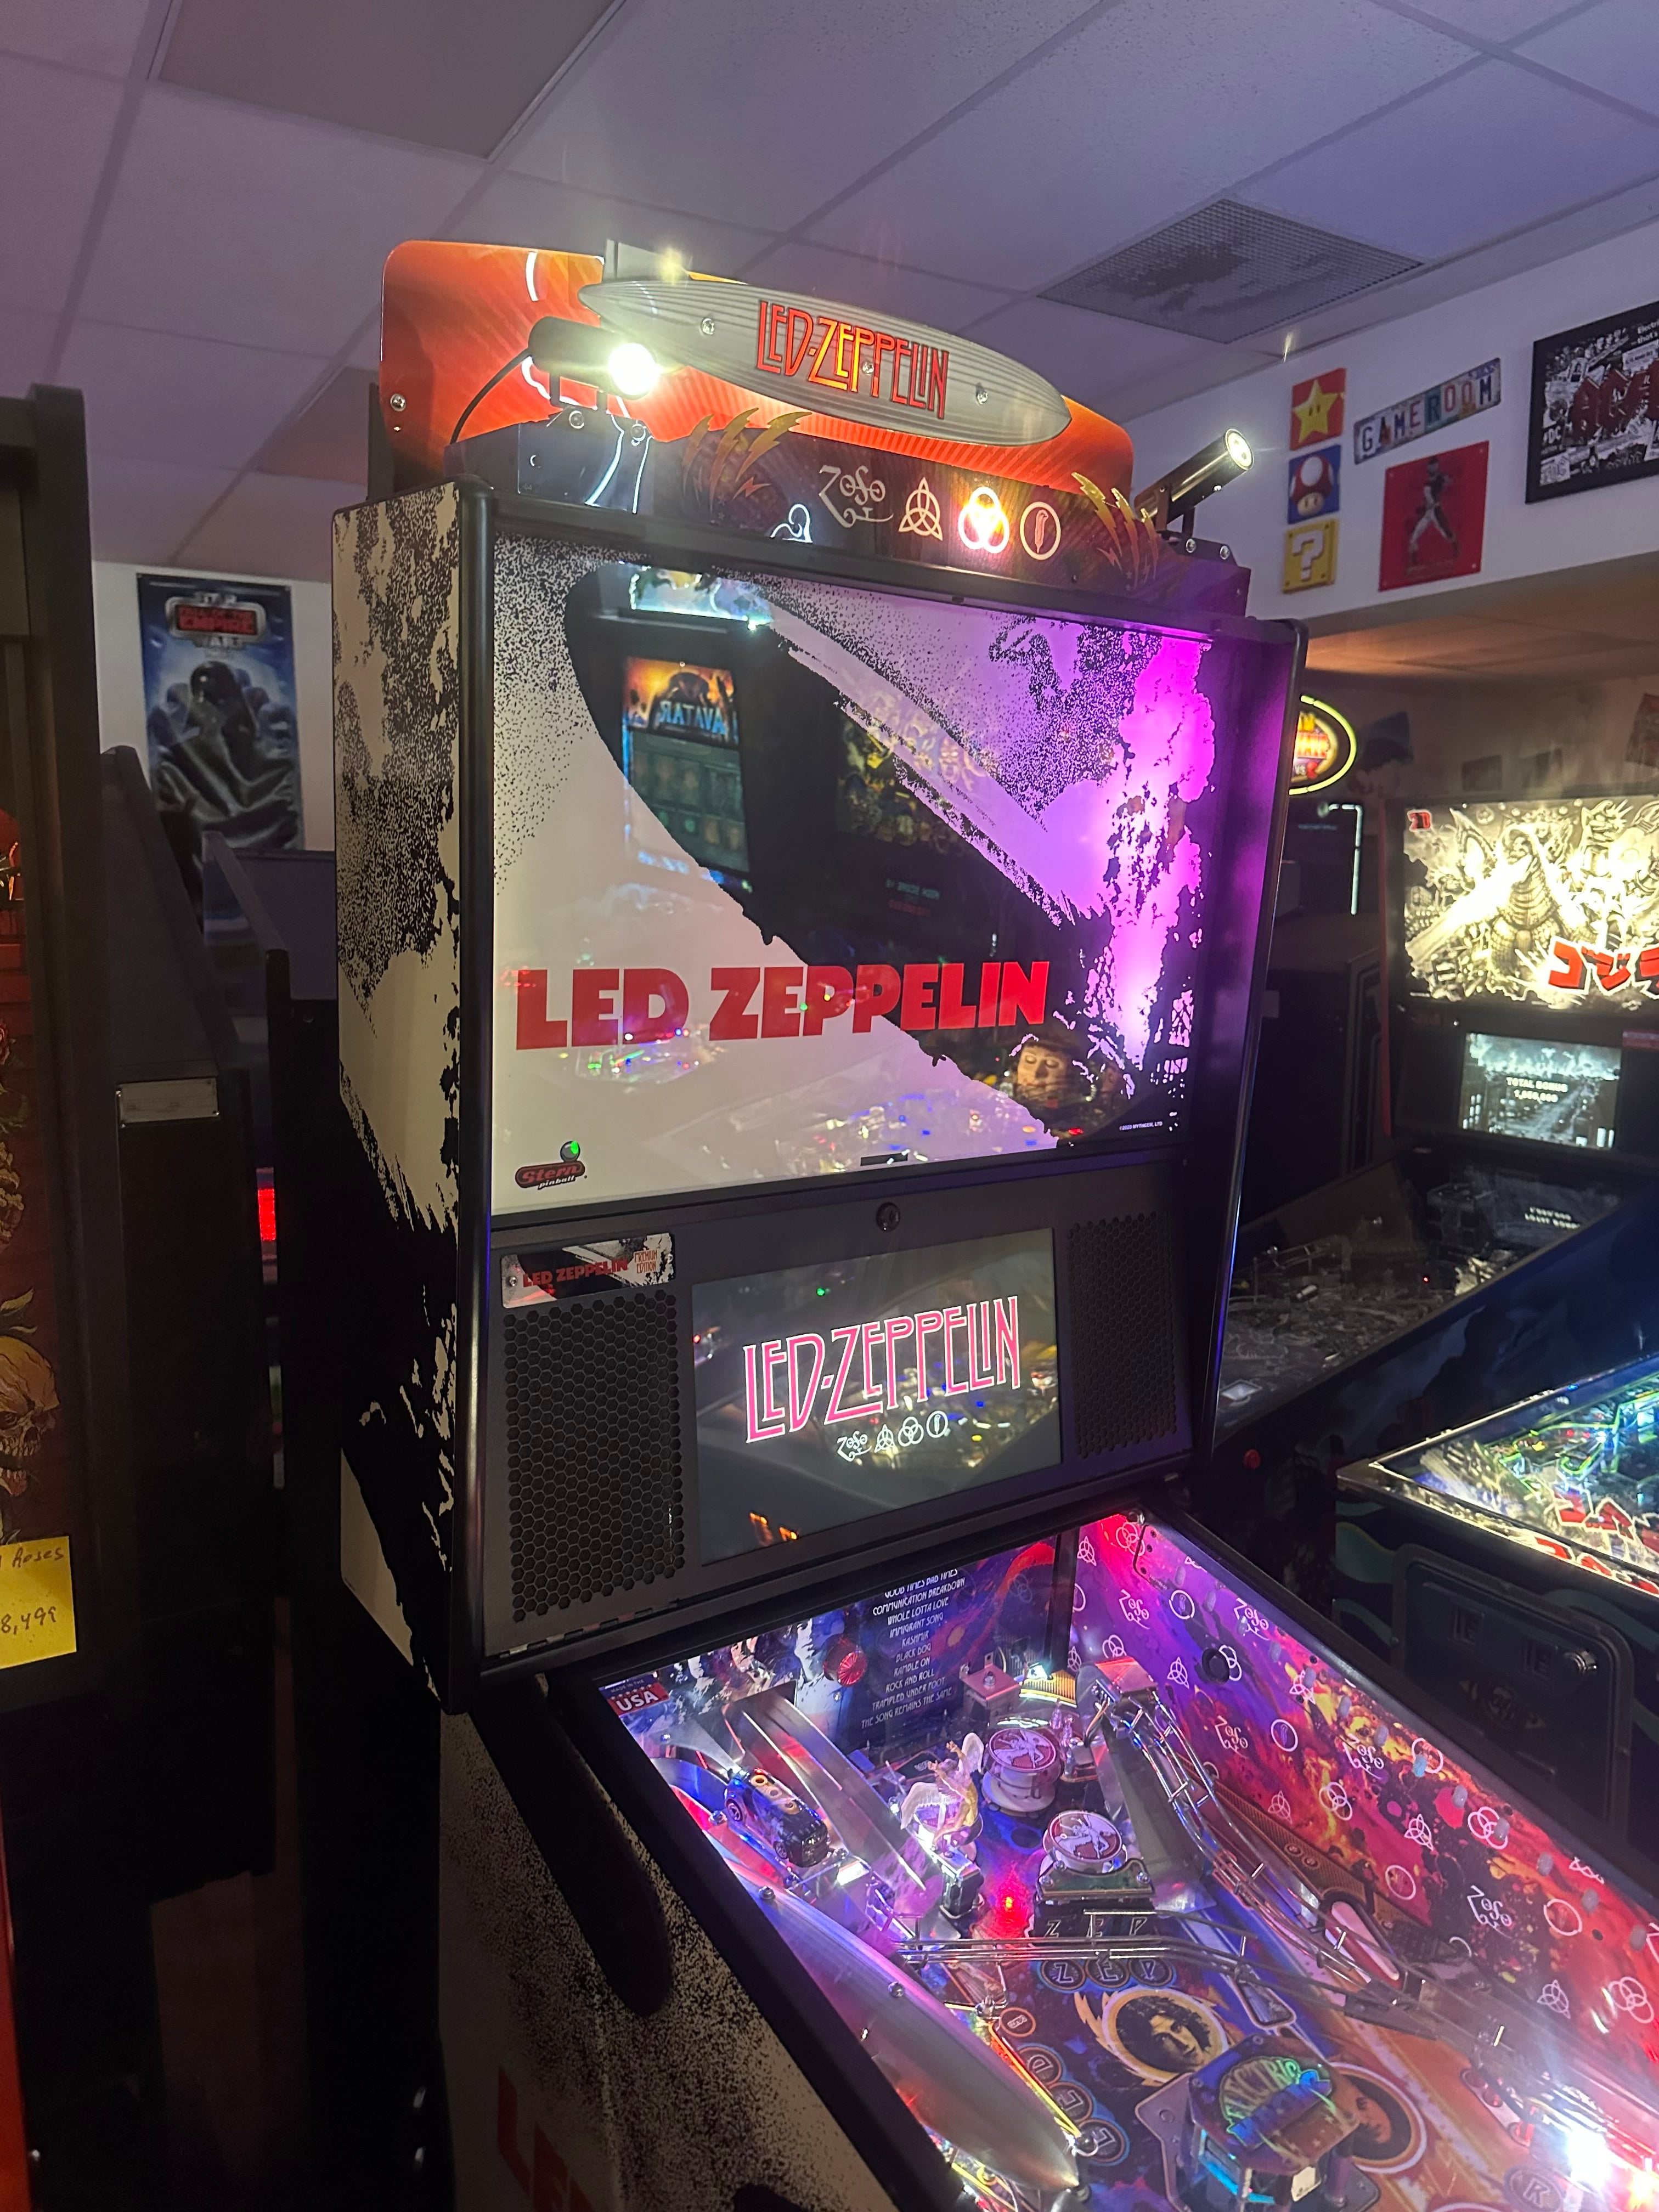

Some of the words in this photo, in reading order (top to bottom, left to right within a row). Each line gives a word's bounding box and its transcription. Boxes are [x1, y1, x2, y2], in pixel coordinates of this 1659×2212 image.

[757, 301, 950, 420] LED-ZEPPELIN
[516, 967, 690, 1051] LED
[709, 961, 1051, 1041] ZEPPELIN
[1506, 1076, 1535, 1089] TOTAL
[522, 1165, 578, 1183] Stern
[538, 1175, 575, 1189] pinball
[634, 1249, 658, 1263] PREMIUM
[636, 1261, 657, 1274] EDITION
[523, 1270, 553, 1288] LED
[556, 1257, 629, 1282] ZEPPELIN
[742, 1295, 1021, 1443] LED-ZEPPELIN
[872, 1592, 927, 1616] COMMUNICATION
[928, 1577, 966, 1599] BREAKDOWN
[887, 1611, 910, 1626] WHOLE
[911, 1602, 932, 1617] LOTTA
[933, 1596, 949, 1610] LOVE
[889, 1620, 924, 1639] IMMIGRANT
[926, 1612, 944, 1626] SONG
[901, 1630, 929, 1648] KASHMIR
[895, 1648, 916, 1663] BLACK
[917, 1643, 931, 1656] DOG
[894, 1661, 919, 1677] RAMBLE
[920, 1656, 931, 1667] ON
[872, 1691, 905, 1712] TRAMPLED
[906, 1684, 927, 1699] UNDER
[928, 1676, 946, 1691] FOOT
[885, 1678, 904, 1694] ROCK
[904, 1674, 918, 1687] AND
[918, 1668, 935, 1681] ROLL
[616, 1690, 659, 1711] USA
[861, 1717, 874, 1730] THE
[874, 1708, 894, 1724] SONG
[894, 1699, 922, 1717] REMAINS
[923, 1694, 935, 1706] THE
[935, 1686, 953, 1701] SAME
